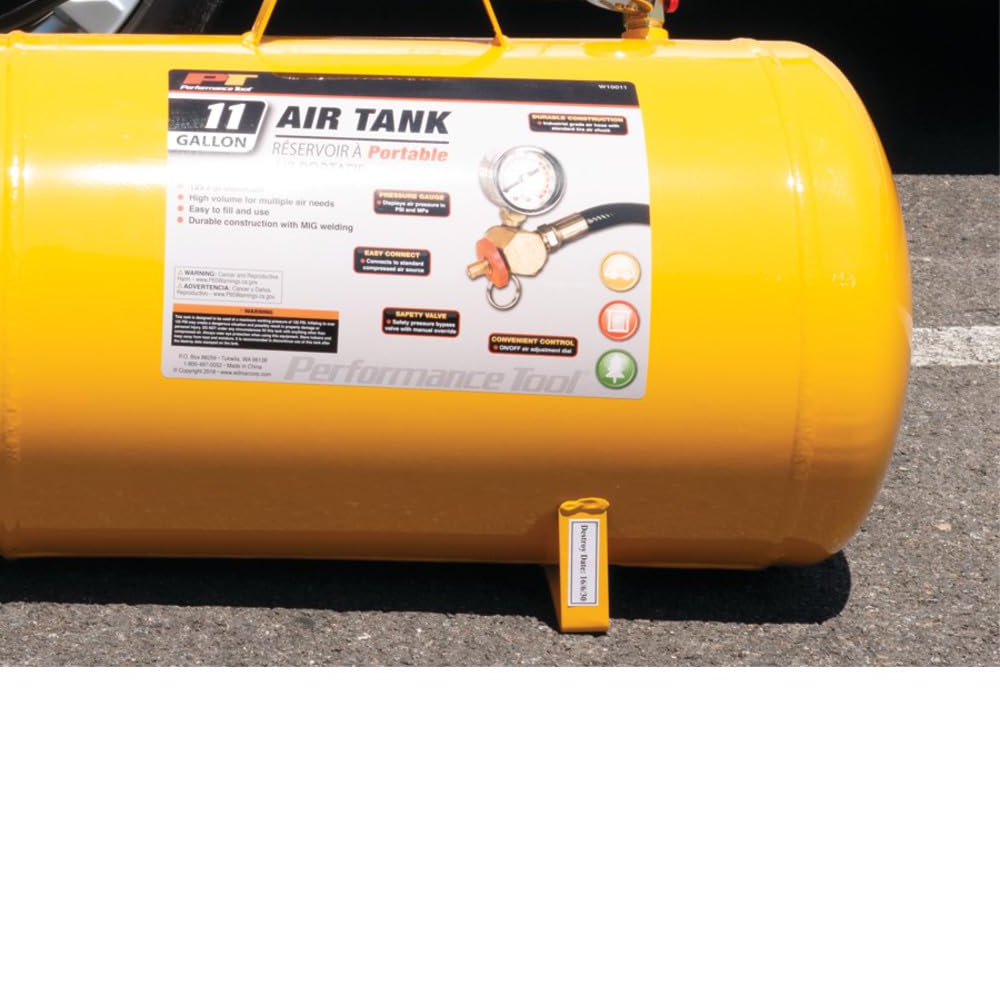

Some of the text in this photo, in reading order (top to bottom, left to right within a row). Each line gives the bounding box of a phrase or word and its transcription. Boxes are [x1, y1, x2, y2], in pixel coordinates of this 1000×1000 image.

[204, 102, 246, 130] 11
[275, 106, 452, 134] AIR TANK
[176, 134, 247, 148] GALLON
[272, 139, 349, 157] RÉSERVOIR
[368, 145, 448, 162] Portable
[189, 194, 335, 208] High volume for multiple air needs
[189, 205, 210, 215] Easy
[212, 206, 220, 214] to
[223, 206, 233, 214] fill
[236, 207, 251, 215] and
[188, 216, 354, 233] Durable construction with MIG welding
[385, 251, 421, 259] CONNECT
[395, 311, 448, 320] SAFETY VALVE
[491, 336, 575, 346] CONVENIENT CONTROL
[285, 355, 582, 394] Performance Tool
[578, 524, 589, 552] Destroy
[580, 554, 589, 574] Date:
